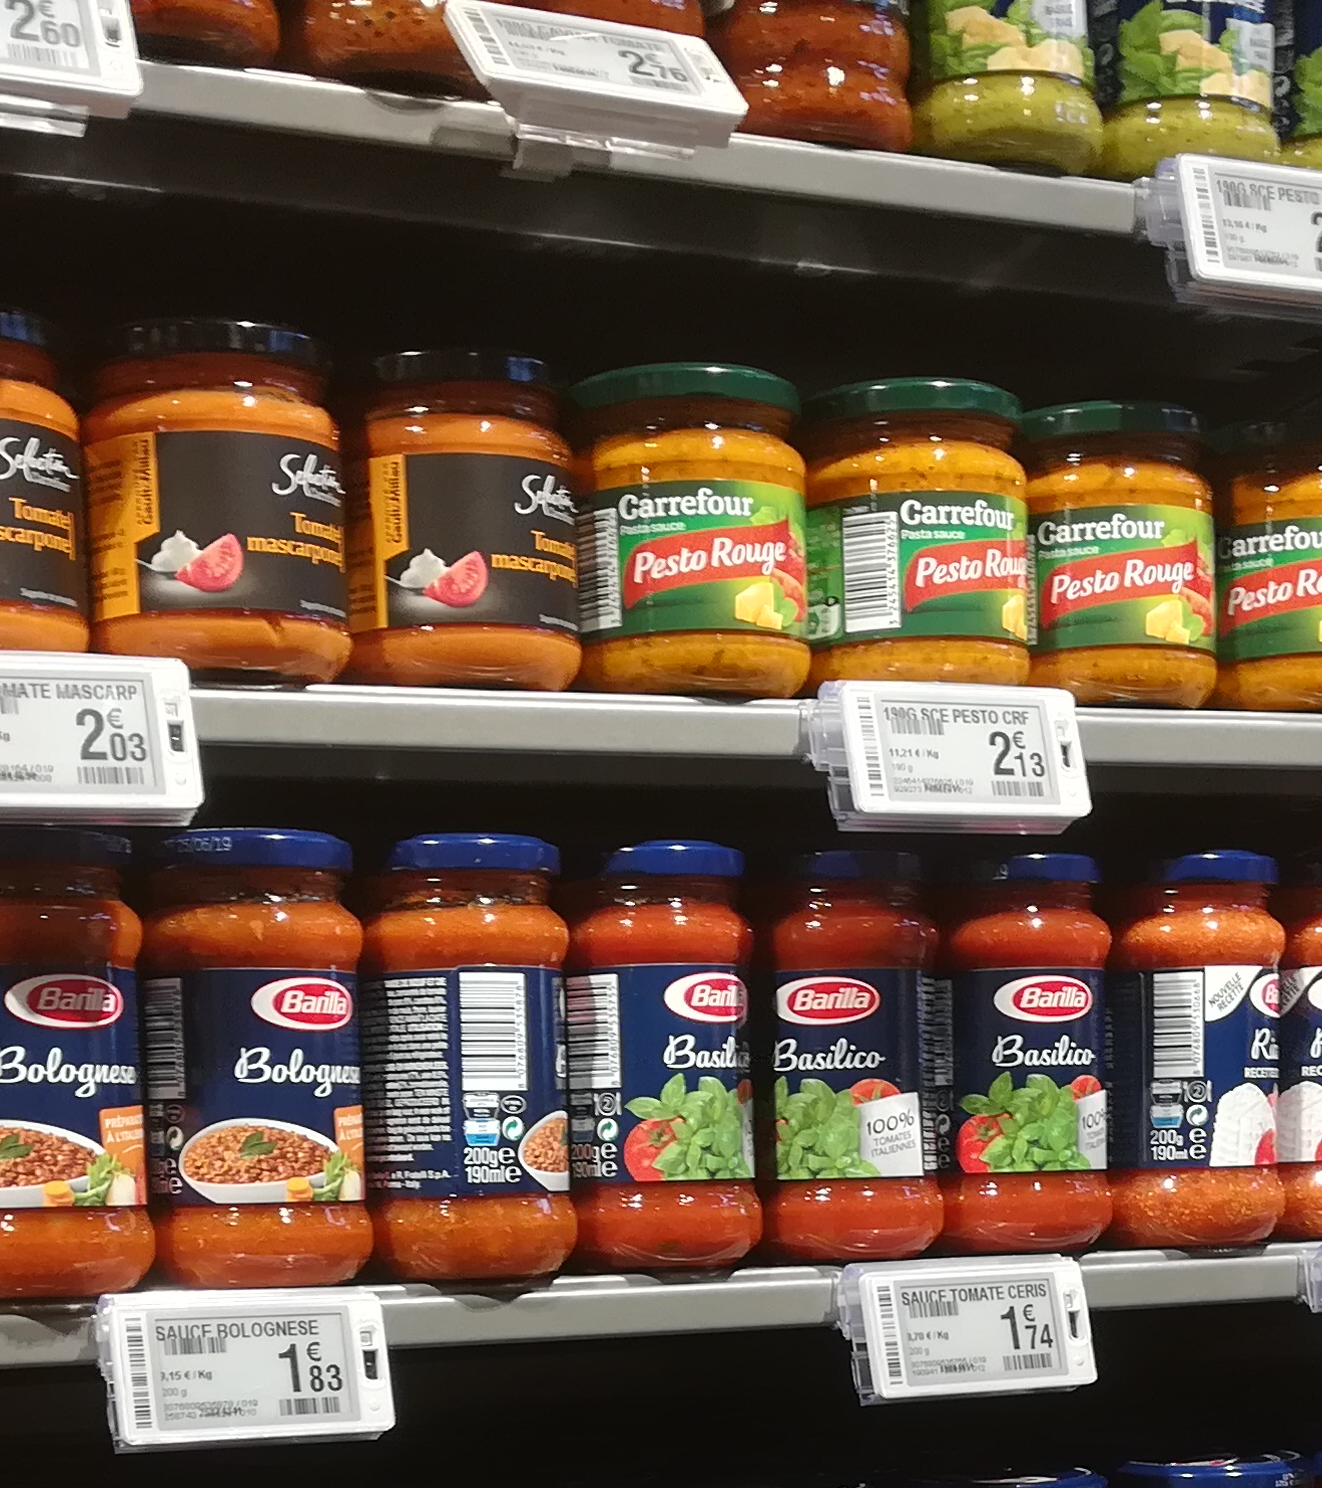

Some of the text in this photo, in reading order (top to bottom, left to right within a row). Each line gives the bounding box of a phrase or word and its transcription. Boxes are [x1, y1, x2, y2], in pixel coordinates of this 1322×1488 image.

[619, 488, 753, 522] Carrefour
[899, 500, 1014, 530] Carrefour
[1038, 515, 1165, 546] Carrefour
[634, 538, 786, 582] Pesto Rouge
[917, 555, 985, 586] Pesto
[1051, 559, 1194, 601] Pesto Rouge
[1229, 581, 1300, 613] Pesto
[55, 684, 138, 702] MASCARP
[953, 708, 1030, 726] PESTO CRF
[37, 986, 118, 1013] Barilla
[281, 988, 347, 1017] Barilla
[793, 988, 868, 1010] Barilla
[1019, 986, 1085, 1009] Barilla
[774, 1039, 885, 1071] Basilico
[992, 1035, 1095, 1068] Basilico
[866, 1108, 915, 1135] 100%
[949, 1286, 1005, 1301] TOMATE
[1008, 1284, 1046, 1298] CERIS
[217, 1320, 319, 1337] BOLOGNESE
